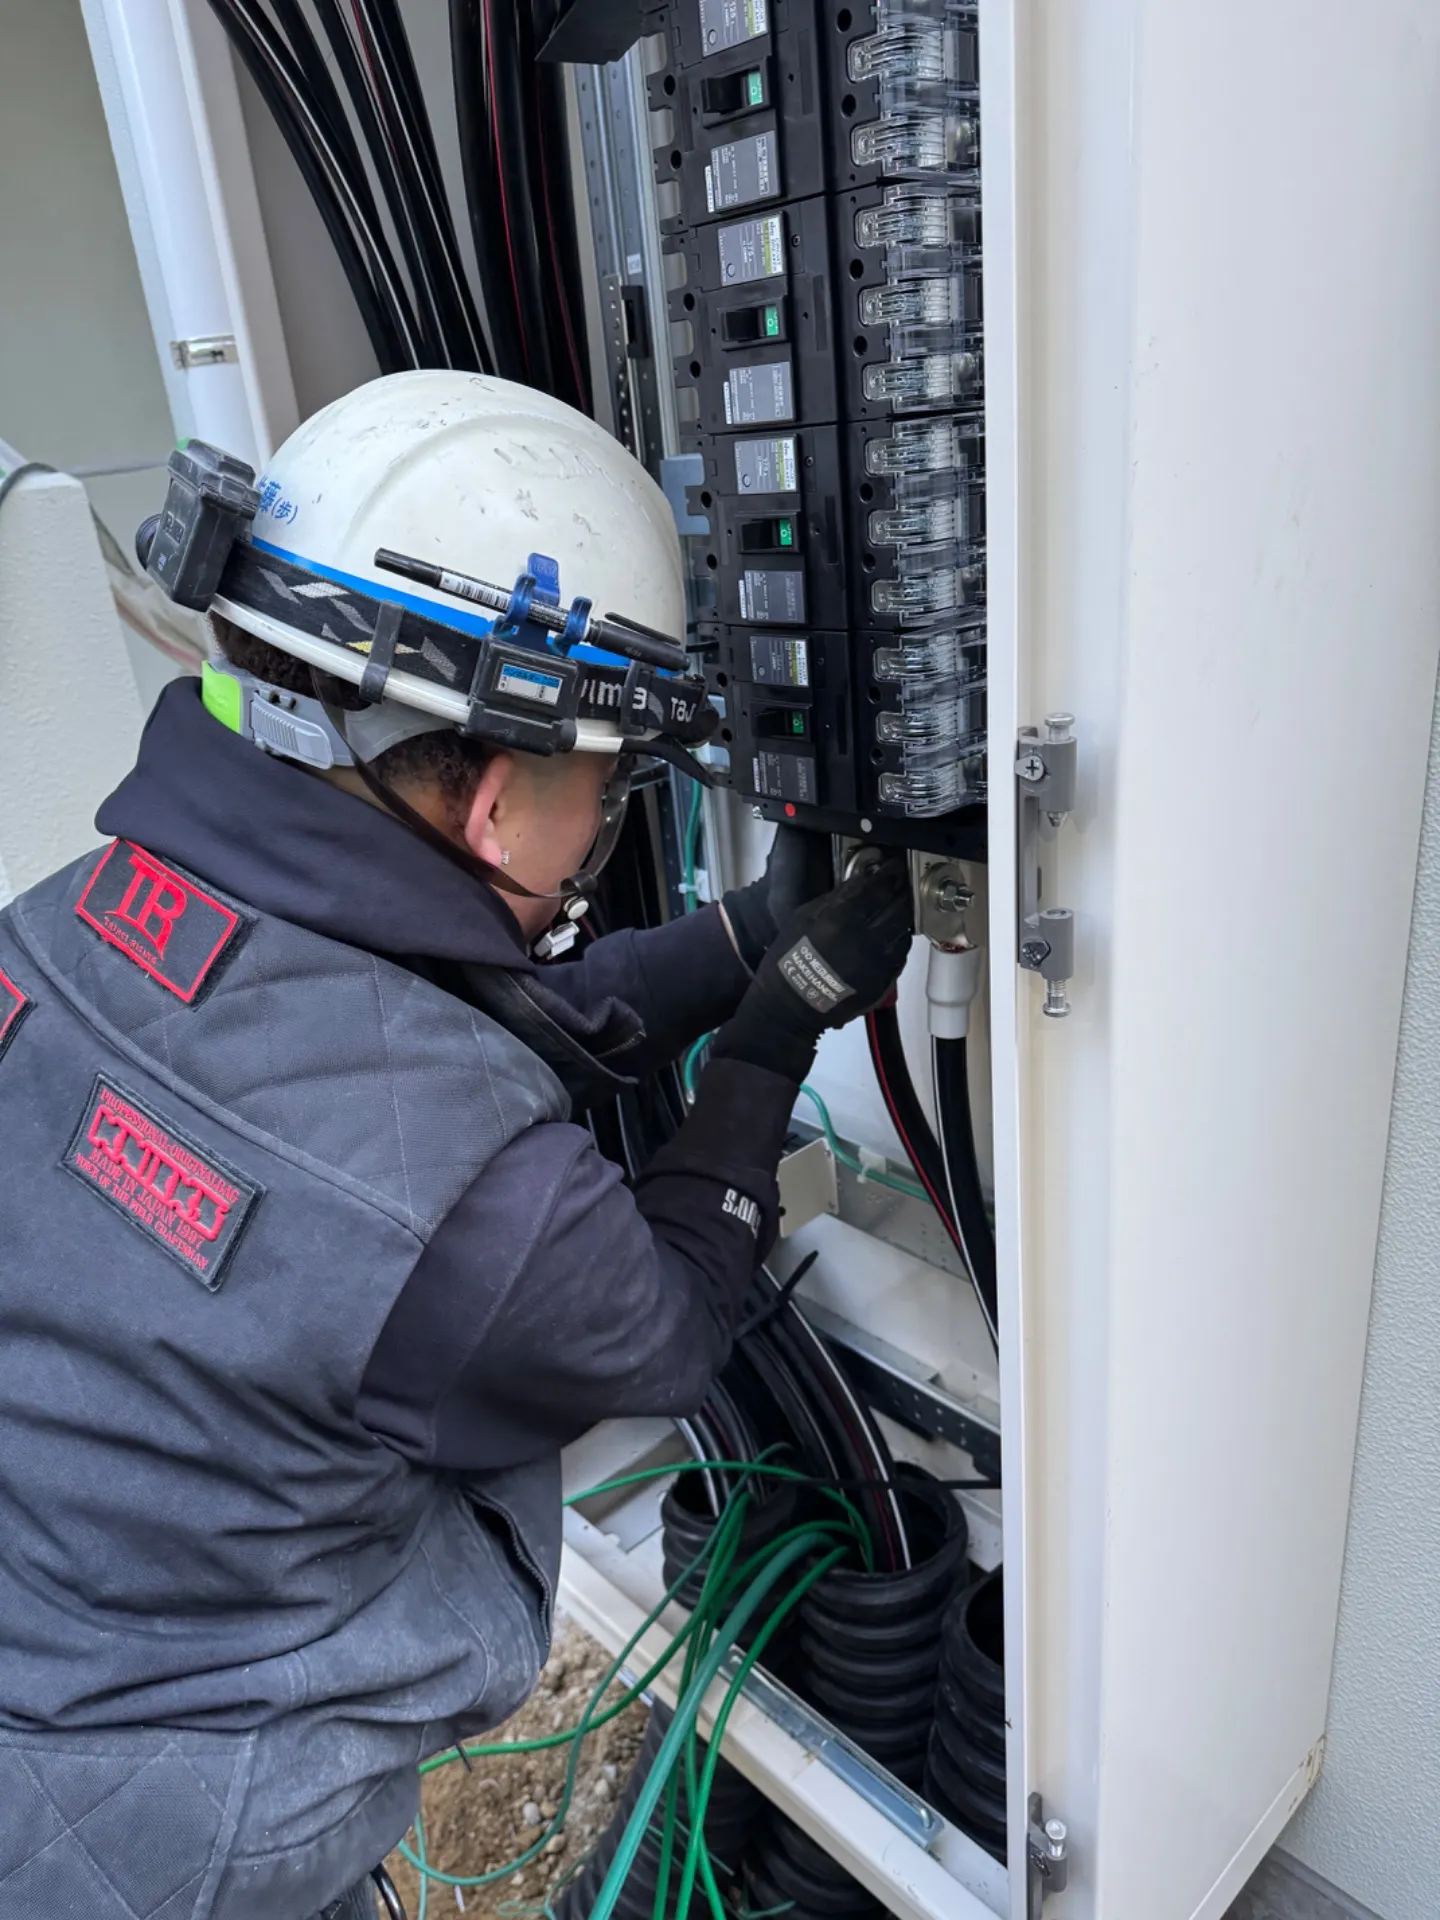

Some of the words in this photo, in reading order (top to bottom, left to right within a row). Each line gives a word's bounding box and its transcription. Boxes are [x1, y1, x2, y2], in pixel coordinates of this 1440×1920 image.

[88, 1148, 123, 1183] MADE
[122, 1176, 139, 1195] IN
[137, 1188, 178, 1228] JAPAN
[99, 1175, 112, 1189] OF
[110, 1183, 131, 1206] THE
